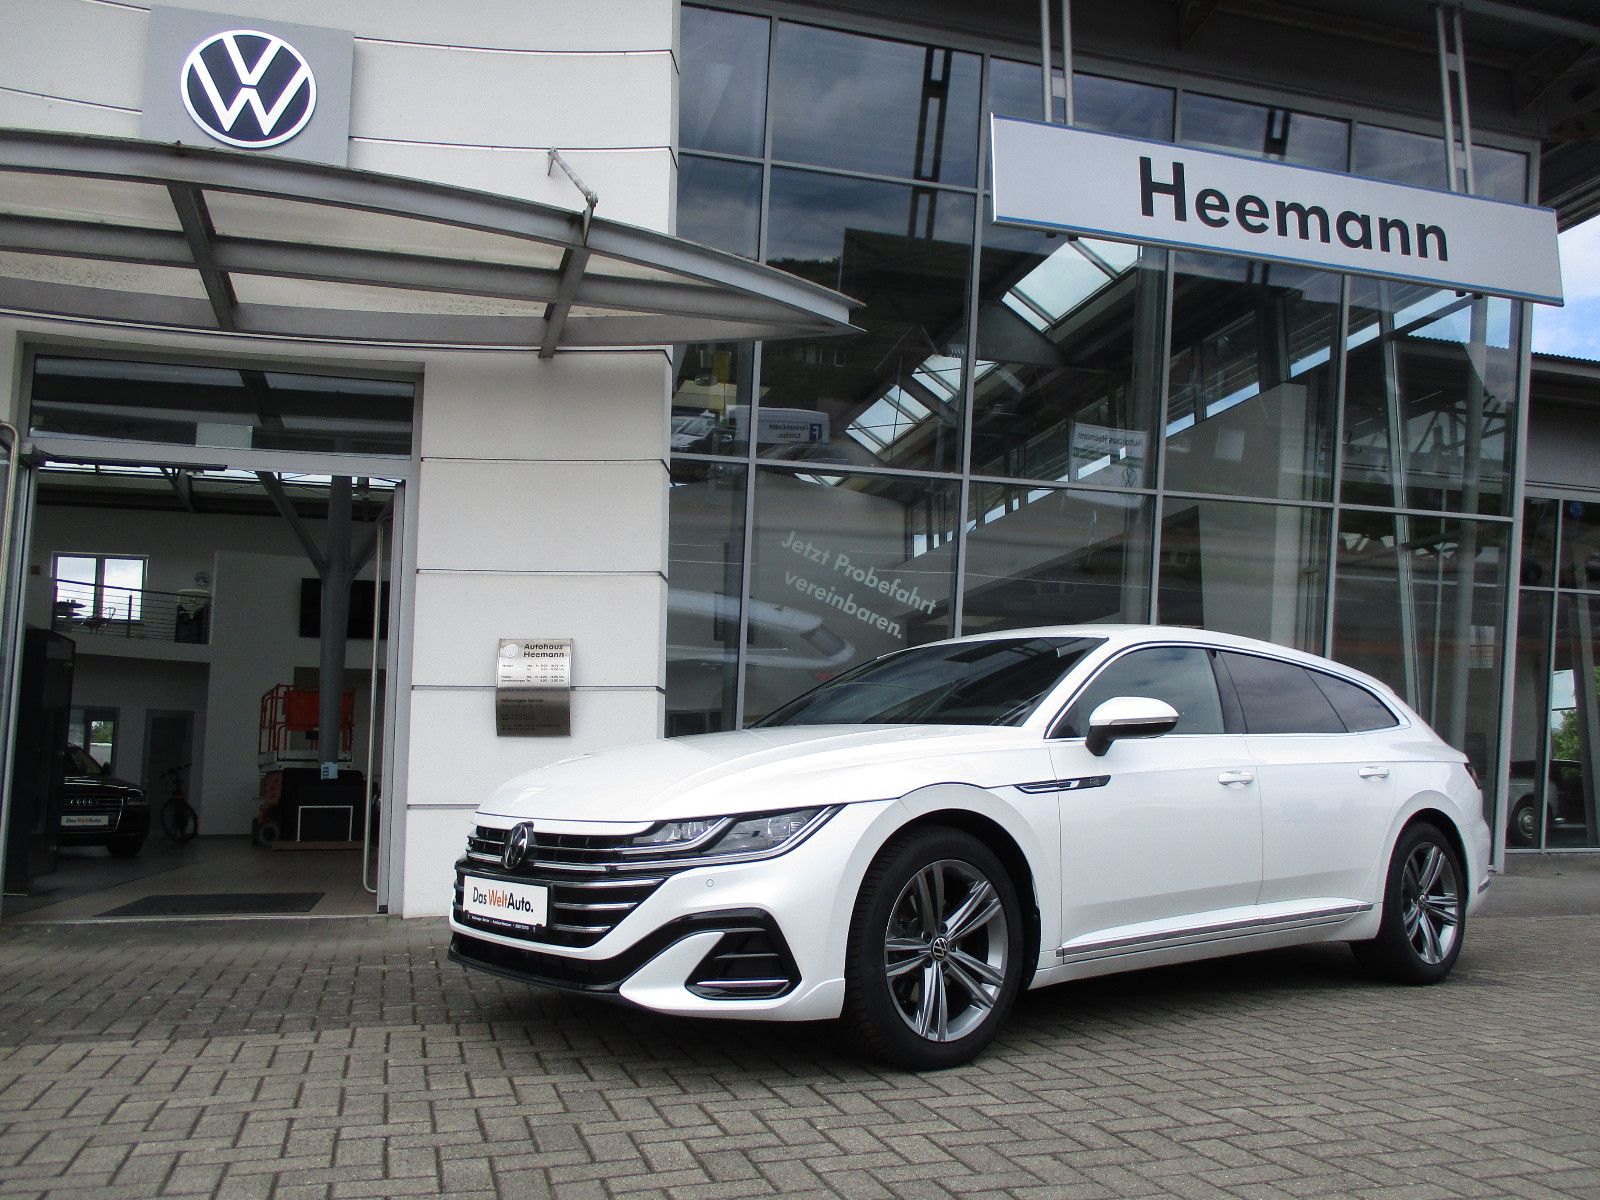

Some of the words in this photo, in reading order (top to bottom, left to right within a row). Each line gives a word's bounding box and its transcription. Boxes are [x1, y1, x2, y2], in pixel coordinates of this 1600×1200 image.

[1139, 156, 1448, 261] Heemann
[780, 530, 831, 565] Jetzt
[832, 553, 937, 615] Probefahrt
[783, 571, 903, 639] vereinbaren.
[472, 886, 487, 905] Das
